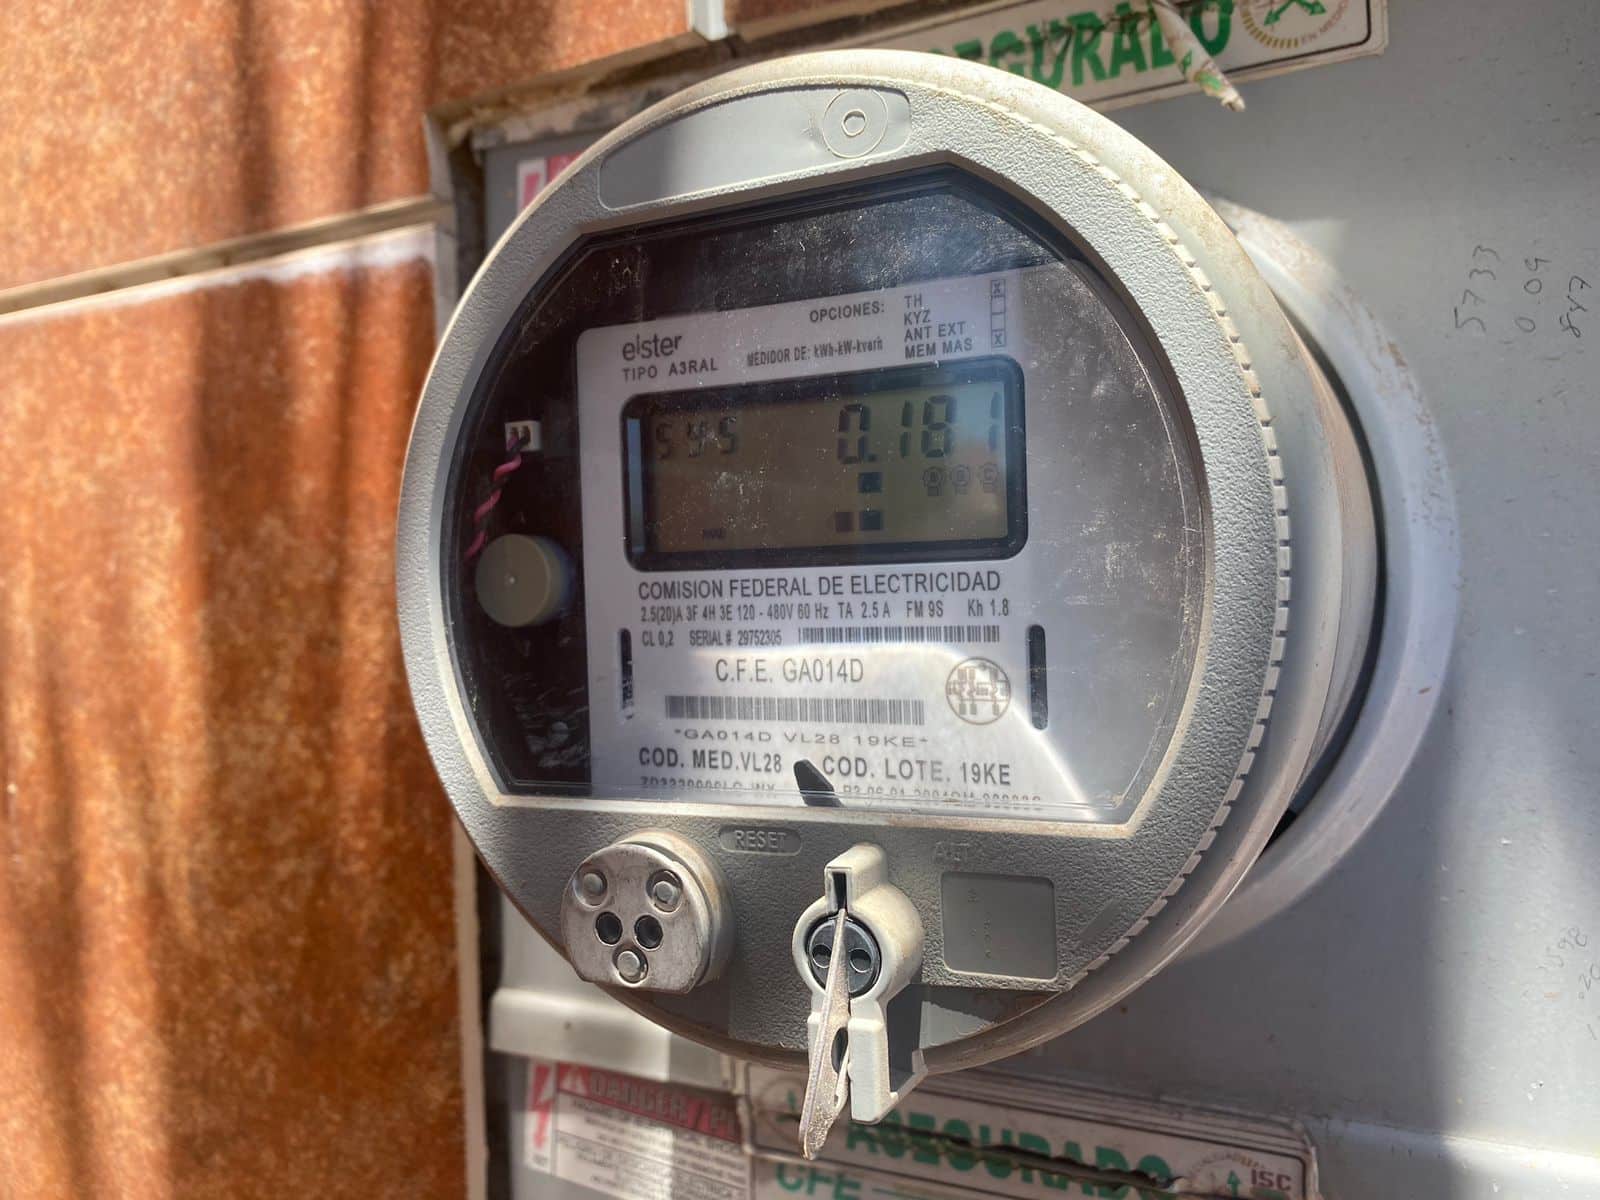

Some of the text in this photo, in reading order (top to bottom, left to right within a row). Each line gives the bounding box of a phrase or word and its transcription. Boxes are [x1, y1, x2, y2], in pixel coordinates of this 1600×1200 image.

[809, 293, 922, 323] OPCIONES: TH
[904, 309, 930, 326] KYZ
[904, 321, 966, 343] ANT EXT
[622, 333, 682, 361] elster
[746, 348, 791, 367] MEDIDOR
[794, 346, 811, 360] DE:
[904, 342, 936, 360] MEM
[942, 337, 973, 355] MAS
[622, 357, 718, 382] TIPO A3RAL
[638, 570, 1001, 600] COMISION FEDERAL DE ELECTRICIDAD
[641, 605, 683, 625] 2.5(20)A
[686, 605, 698, 621] 3F
[702, 605, 716, 621] 4H
[720, 604, 733, 621] 3E
[738, 604, 756, 621] 120
[767, 603, 793, 620] 480V
[799, 603, 810, 619] 60
[815, 602, 829, 619] Hz
[838, 602, 853, 619] TA
[861, 601, 879, 619] 2.5
[883, 602, 890, 618] A
[906, 600, 924, 618] FM
[928, 600, 944, 618] 9S
[967, 598, 983, 617] Kh
[990, 598, 1010, 617] 1.8
[642, 631, 655, 647] CL
[689, 630, 723, 647] SERIAL
[725, 630, 732, 646] #
[738, 630, 782, 646] 29752305
[716, 658, 864, 683] C.F.E. GA014D
[784, 731, 840, 745] VL28
[639, 747, 684, 768] COD.
[822, 755, 874, 778] COD.
[885, 759, 950, 783] LOTE.
[961, 762, 1011, 786] 19KE
[733, 829, 787, 850] RESET
[775, 1163, 862, 1200] CFE
[1251, 1169, 1292, 1192] ISC
